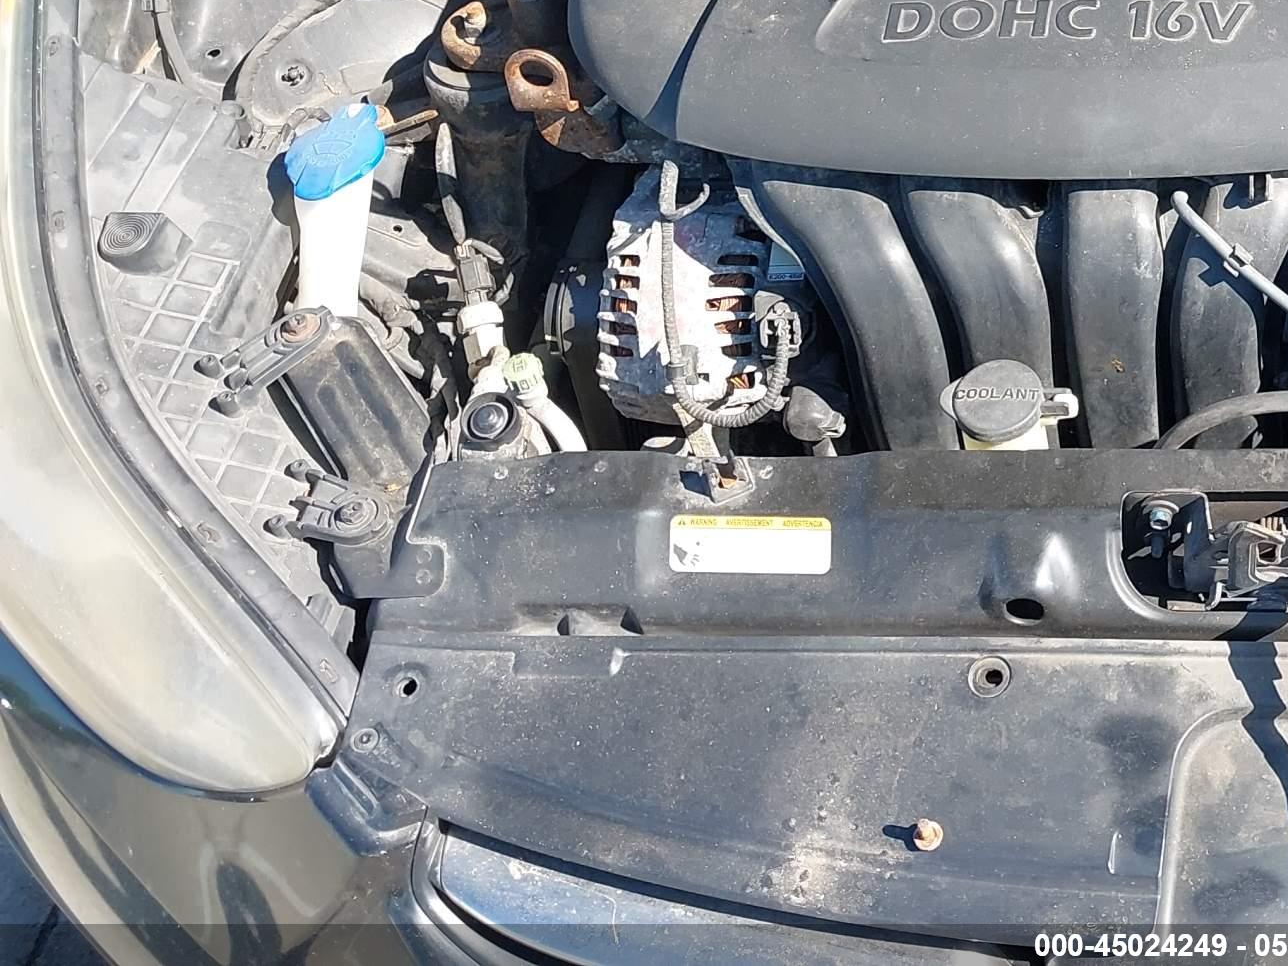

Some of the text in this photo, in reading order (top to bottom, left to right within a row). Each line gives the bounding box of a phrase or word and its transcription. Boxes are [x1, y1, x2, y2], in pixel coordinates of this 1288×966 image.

[1128, 0, 1252, 43] 16V
[955, 387, 1040, 402] COOLANT
[726, 519, 773, 527] AVERTISSEMENT
